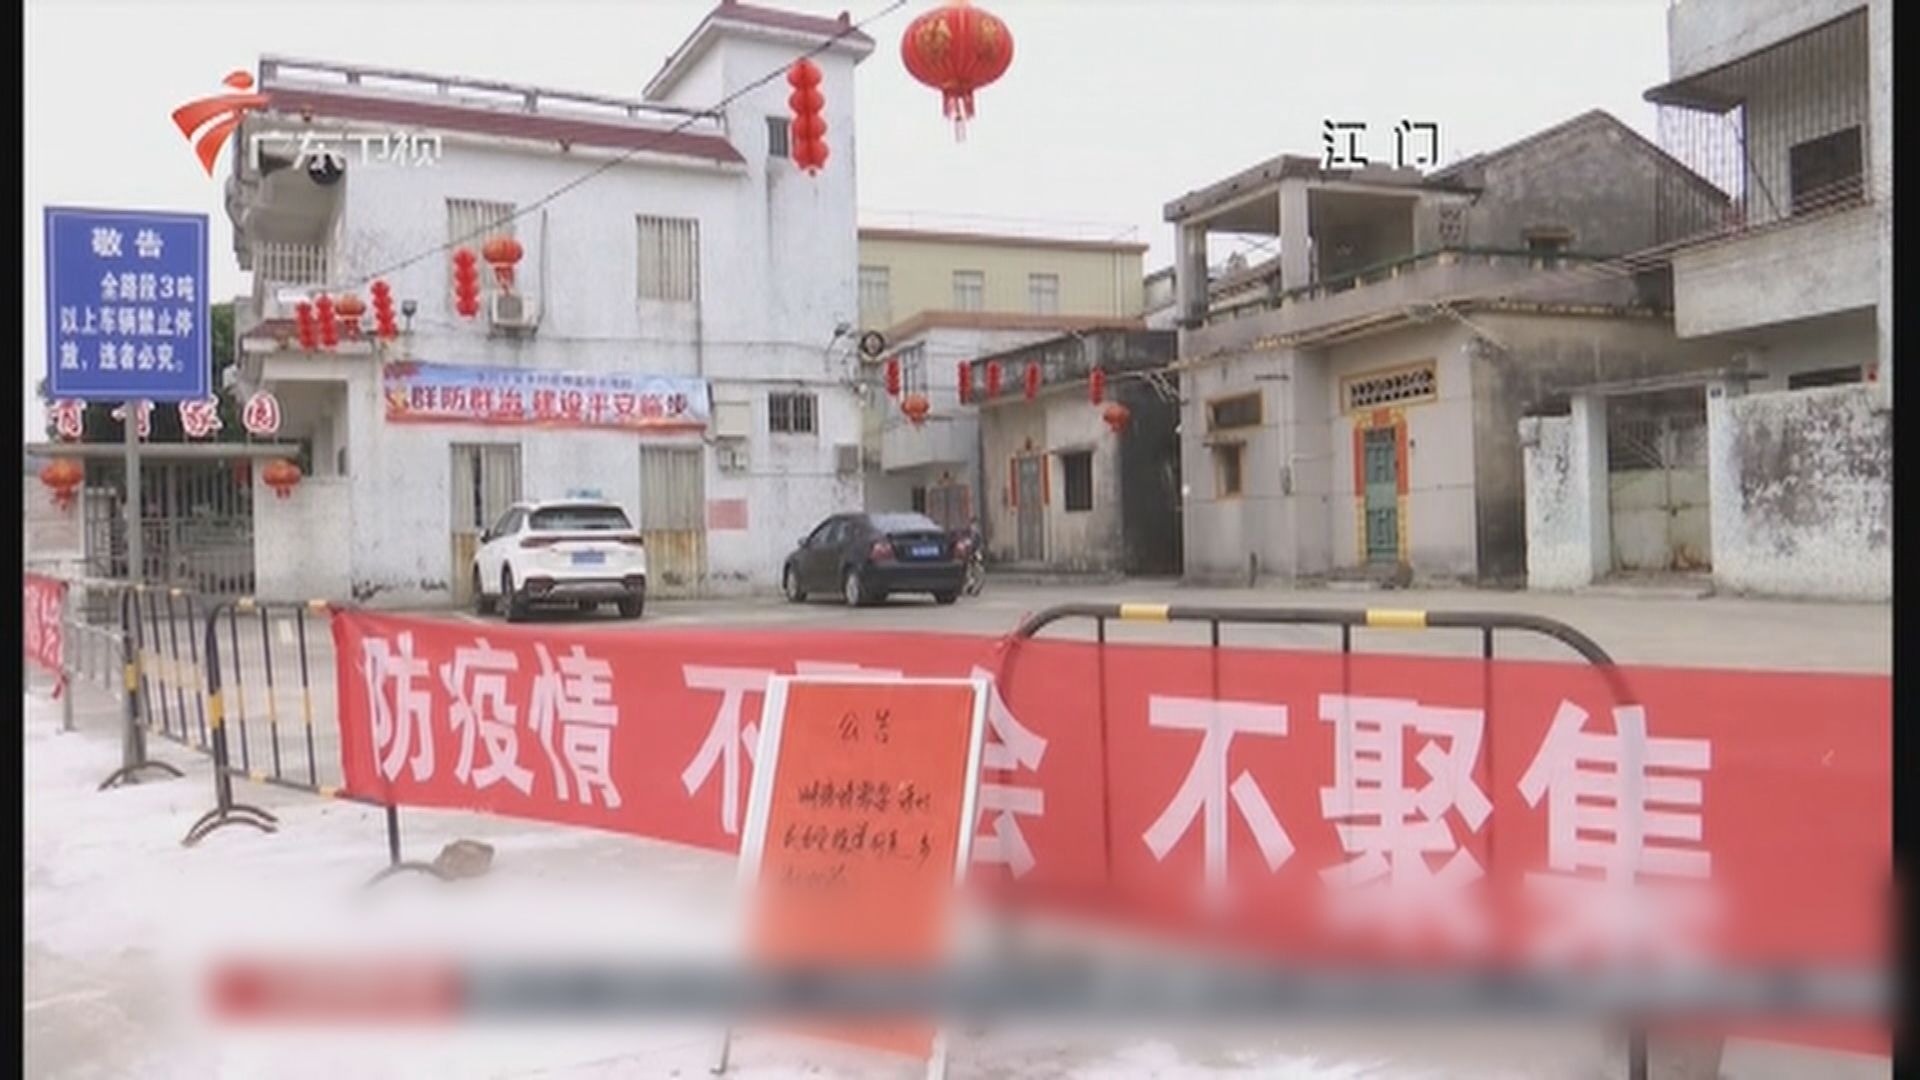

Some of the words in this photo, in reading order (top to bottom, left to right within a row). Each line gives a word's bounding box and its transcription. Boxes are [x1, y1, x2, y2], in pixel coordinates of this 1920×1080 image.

[91, 227, 164, 258] 敬告
[100, 271, 195, 302] 全路段3吨
[60, 305, 193, 337] 以上车辆禁止停
[362, 629, 622, 810] 防疫情
[682, 660, 1048, 880] 不会
